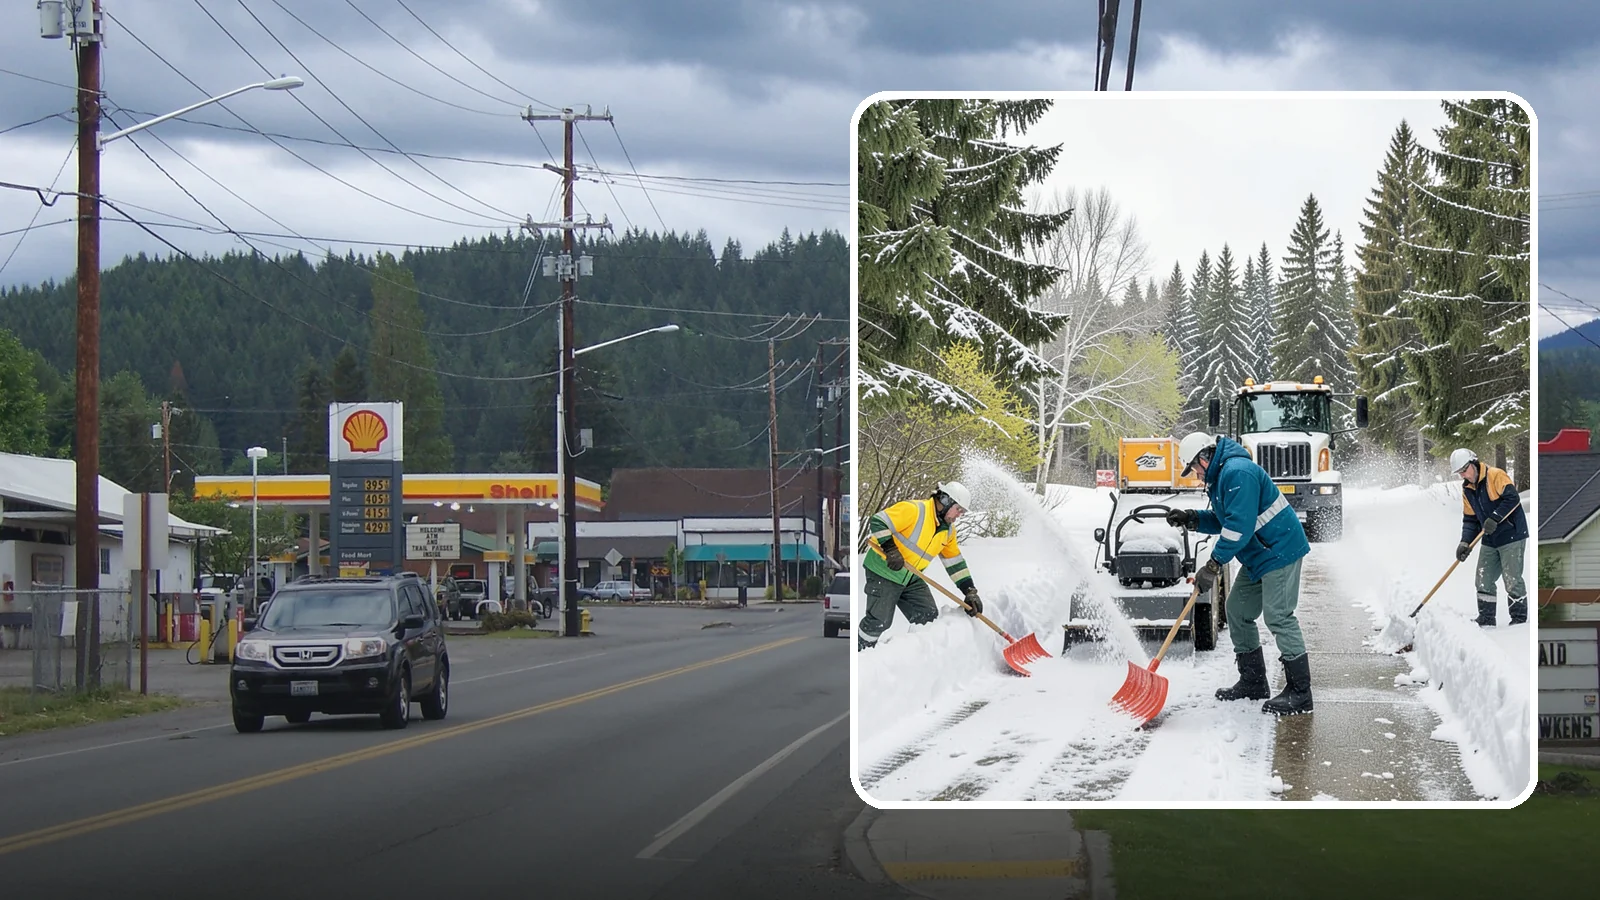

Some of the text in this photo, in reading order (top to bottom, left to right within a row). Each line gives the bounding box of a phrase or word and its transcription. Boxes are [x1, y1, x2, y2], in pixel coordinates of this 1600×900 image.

[365, 480, 383, 490] 395
[490, 484, 547, 499] Shell
[365, 494, 383, 504] 405
[365, 508, 383, 518] 415
[365, 522, 383, 532] 429
[1538, 642, 1567, 665] AID
